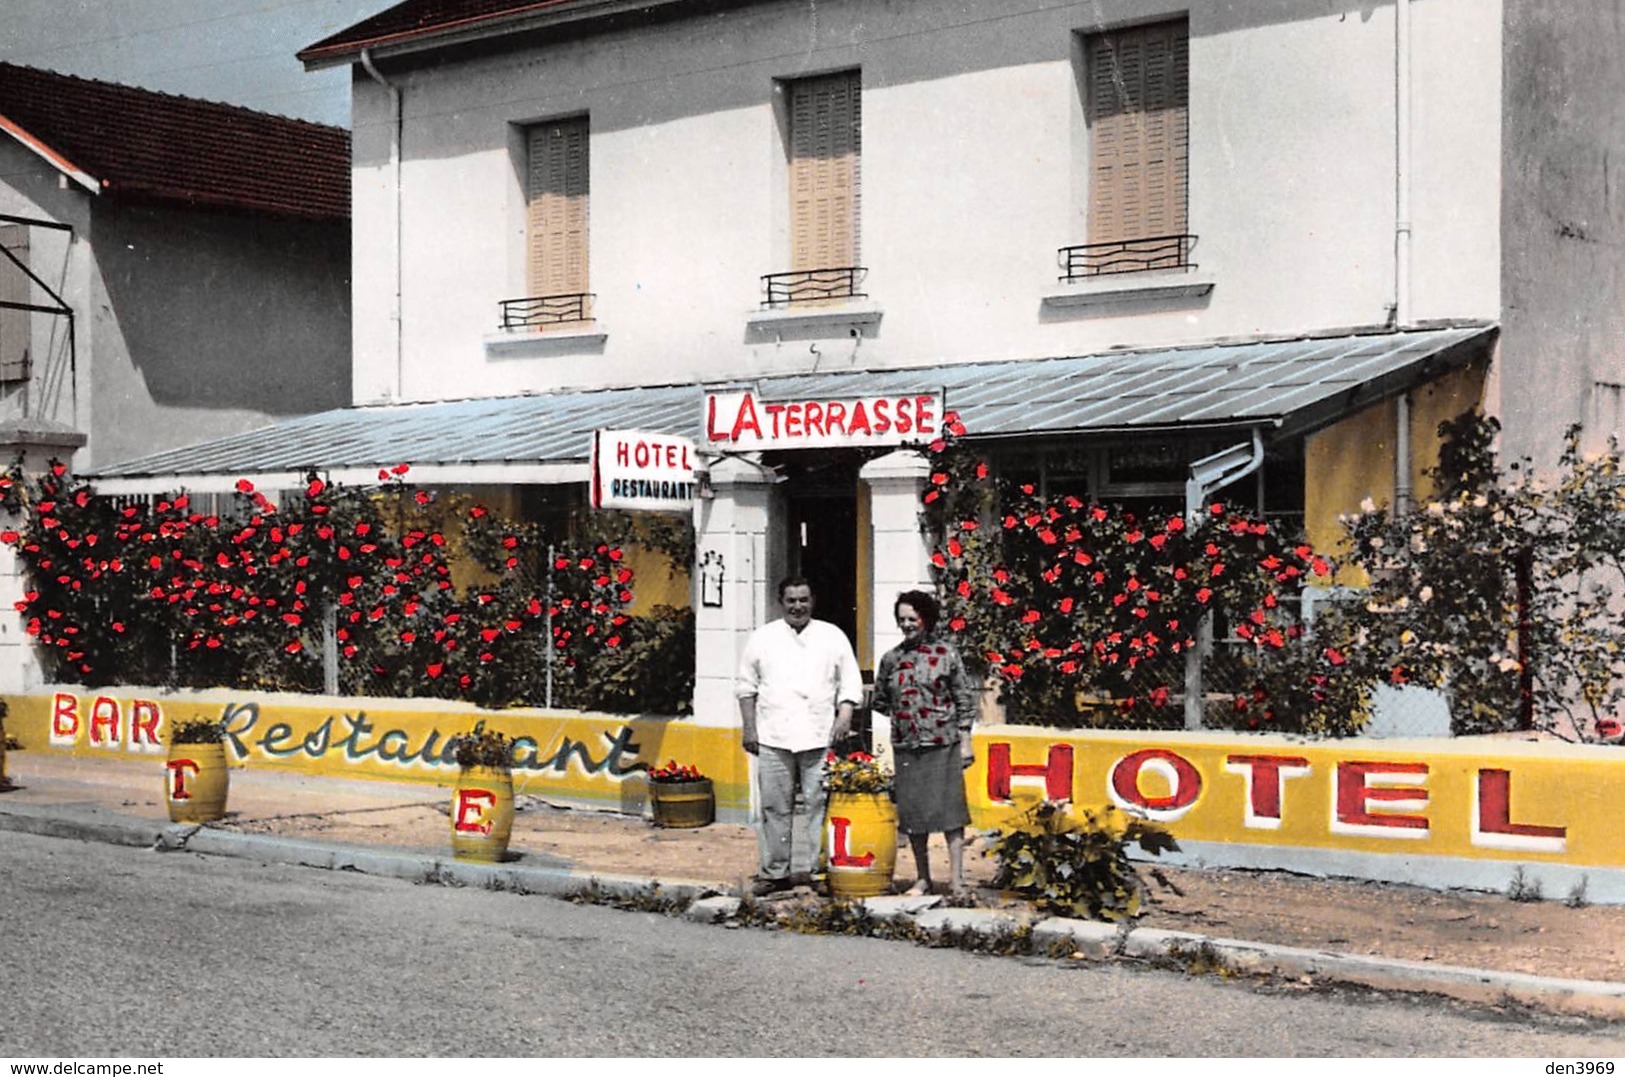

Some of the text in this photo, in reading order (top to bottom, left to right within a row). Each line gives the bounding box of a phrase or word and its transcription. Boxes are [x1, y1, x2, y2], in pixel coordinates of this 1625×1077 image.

[707, 393, 935, 443] LA TERRASSE
[612, 478, 694, 500] RESTAURANT
[50, 692, 648, 777] BAR Restauant
[165, 758, 200, 801] T
[986, 742, 1568, 851] HOTEL
[454, 788, 496, 836] E
[829, 816, 876, 872] L
